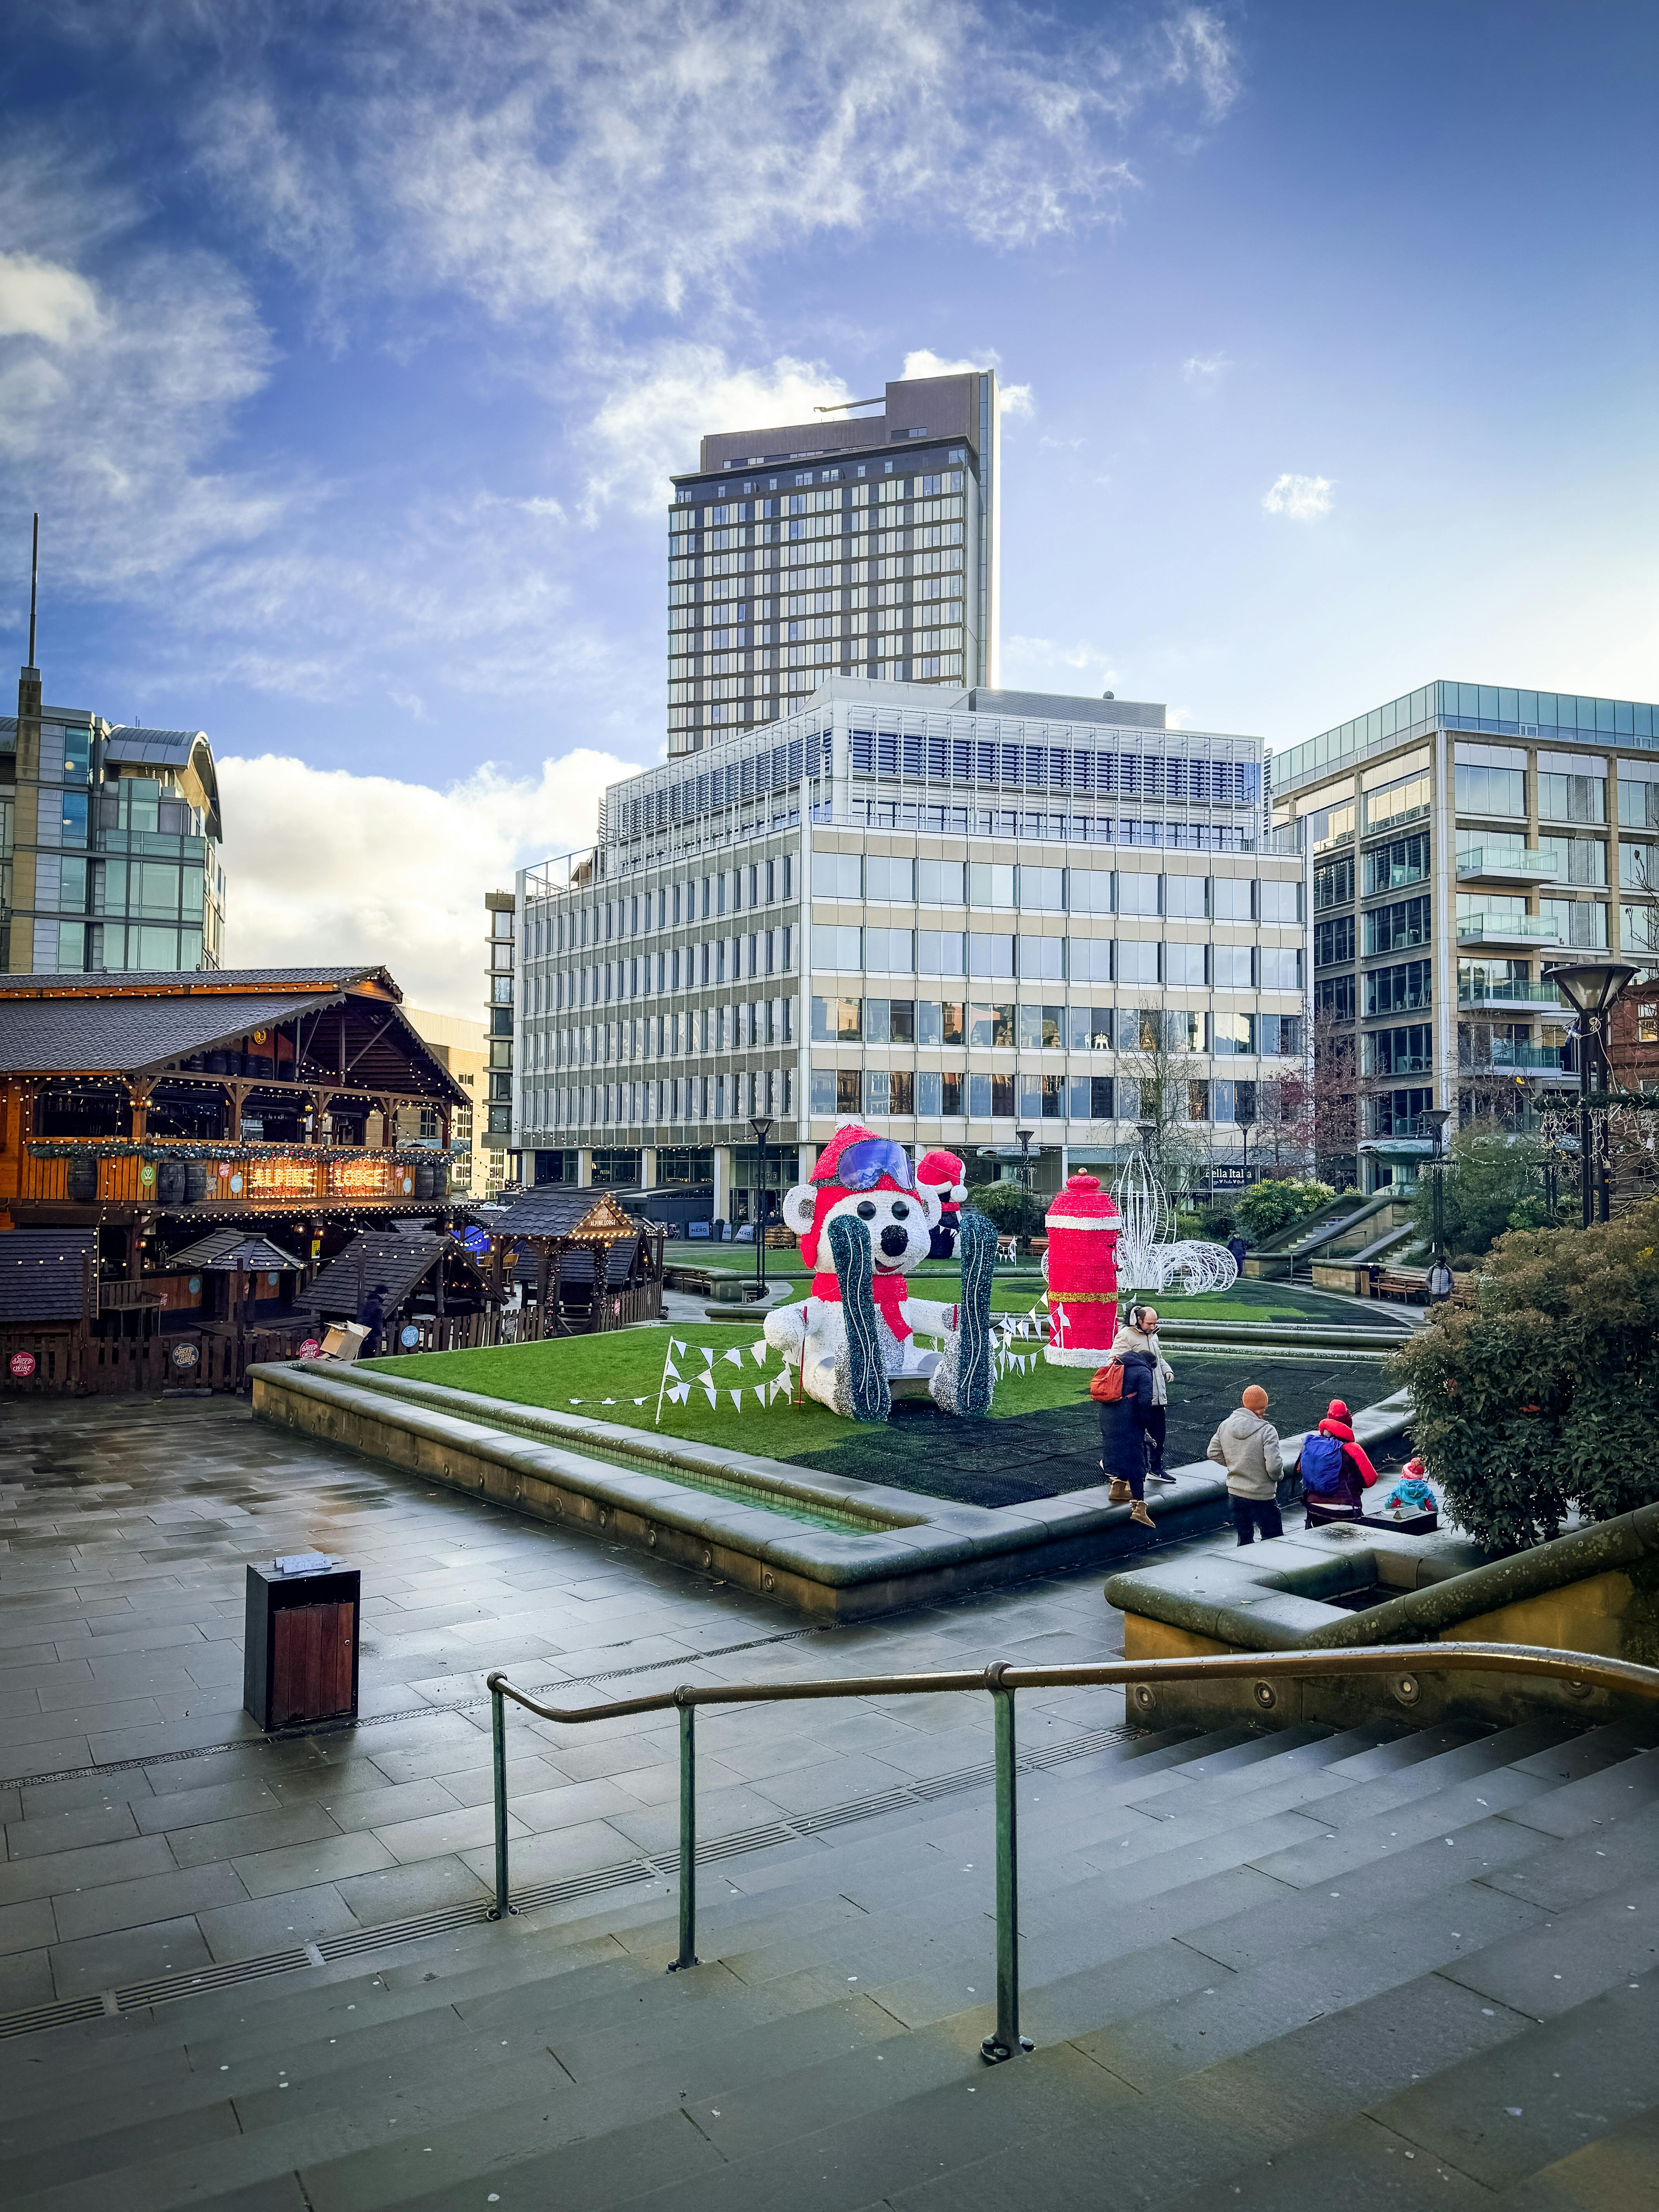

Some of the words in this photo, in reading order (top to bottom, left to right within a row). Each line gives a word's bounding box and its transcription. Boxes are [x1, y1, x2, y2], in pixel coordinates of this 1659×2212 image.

[252, 1168, 313, 1187] ALPINE
[333, 1169, 383, 1187] LODGE
[1229, 1169, 1252, 1178] Itala
[12, 1356, 33, 1364] SPICED
[179, 1355, 195, 1364] CIDER
